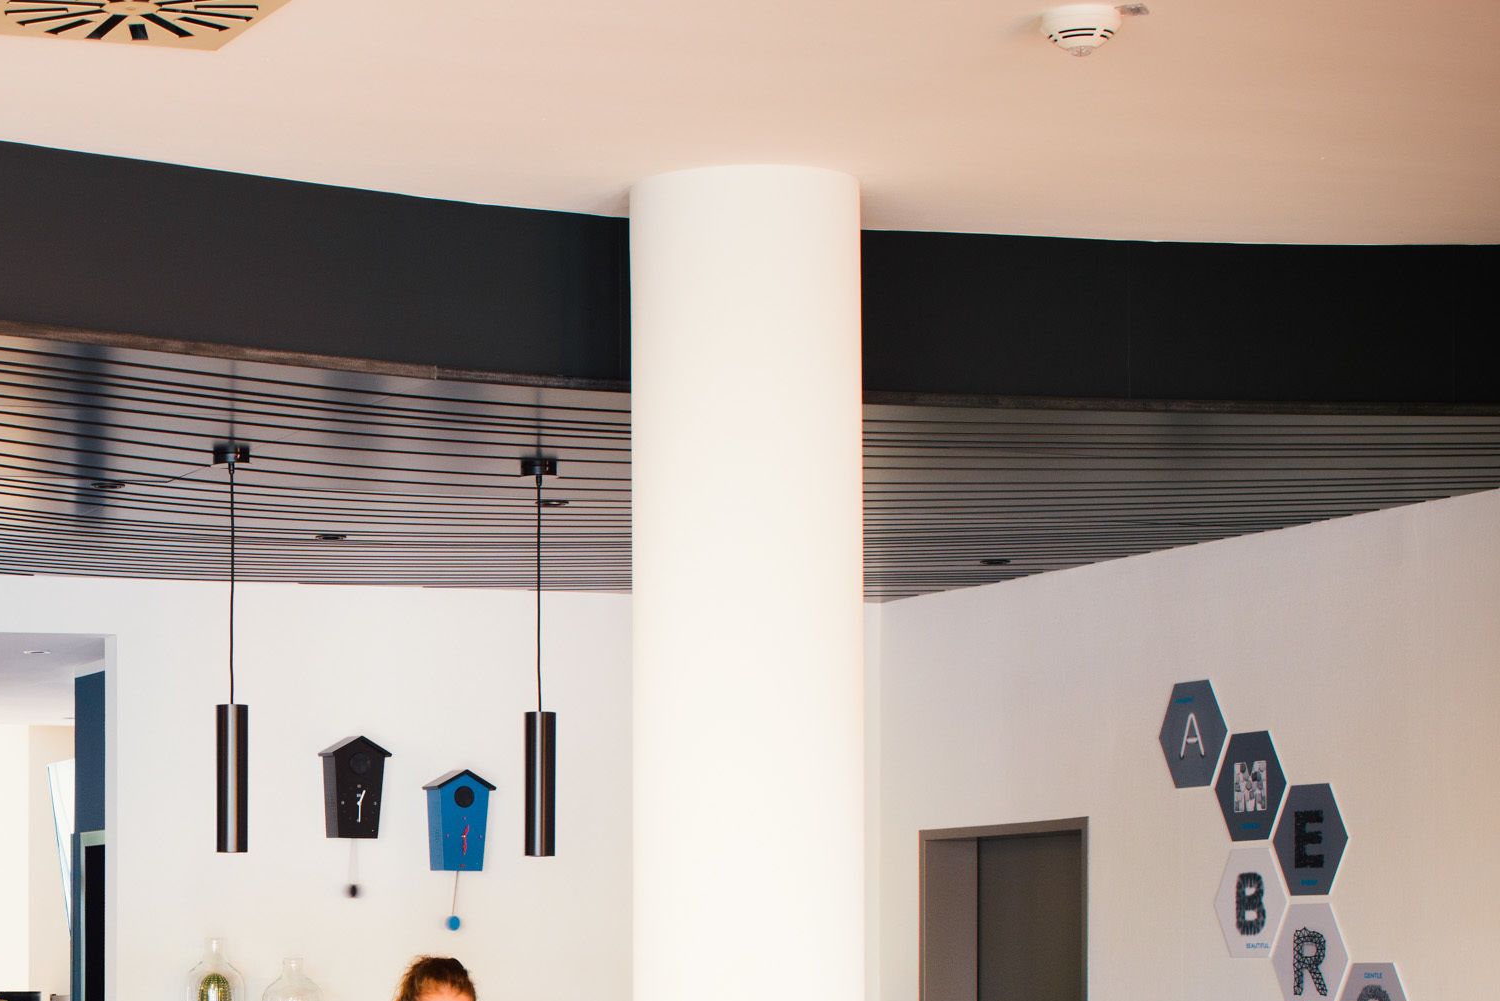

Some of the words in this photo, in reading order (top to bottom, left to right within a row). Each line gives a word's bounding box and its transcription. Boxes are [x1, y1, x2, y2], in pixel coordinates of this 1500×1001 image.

[1179, 712, 1206, 760] A
[1233, 759, 1268, 813] M
[1294, 809, 1325, 869] E
[1235, 871, 1267, 936] B
[1292, 926, 1329, 997] R
